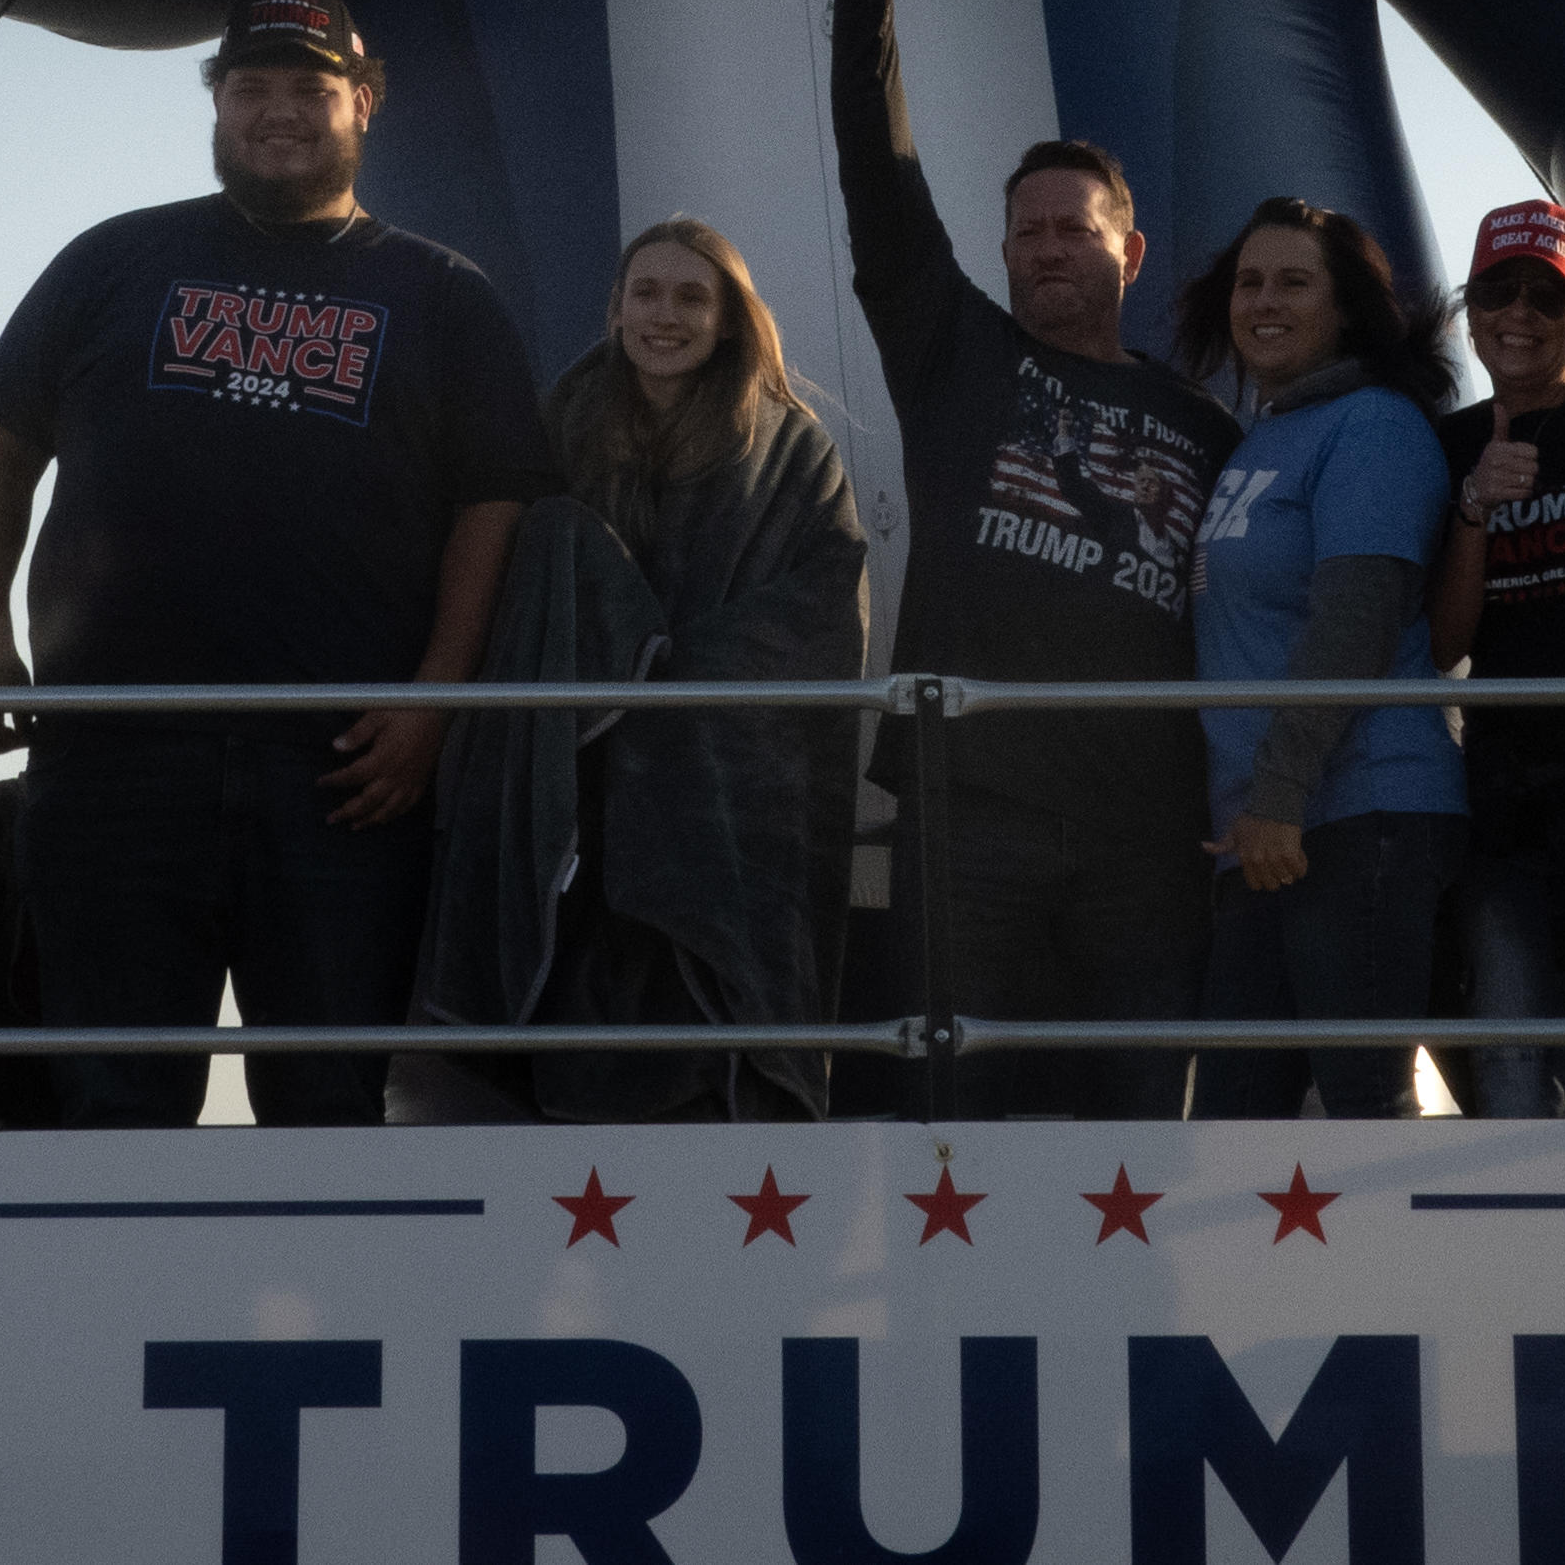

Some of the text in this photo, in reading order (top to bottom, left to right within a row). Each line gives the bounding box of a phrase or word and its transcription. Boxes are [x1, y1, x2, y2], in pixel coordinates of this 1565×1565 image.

[1489, 213, 1526, 230] MAKE
[1492, 232, 1532, 250] GREAT
[178, 288, 377, 341] TRUMP
[170, 317, 371, 390] VANCE
[227, 371, 292, 399] 2024
[976, 506, 1104, 574] TRUMP
[1485, 575, 1541, 589] AMERICA
